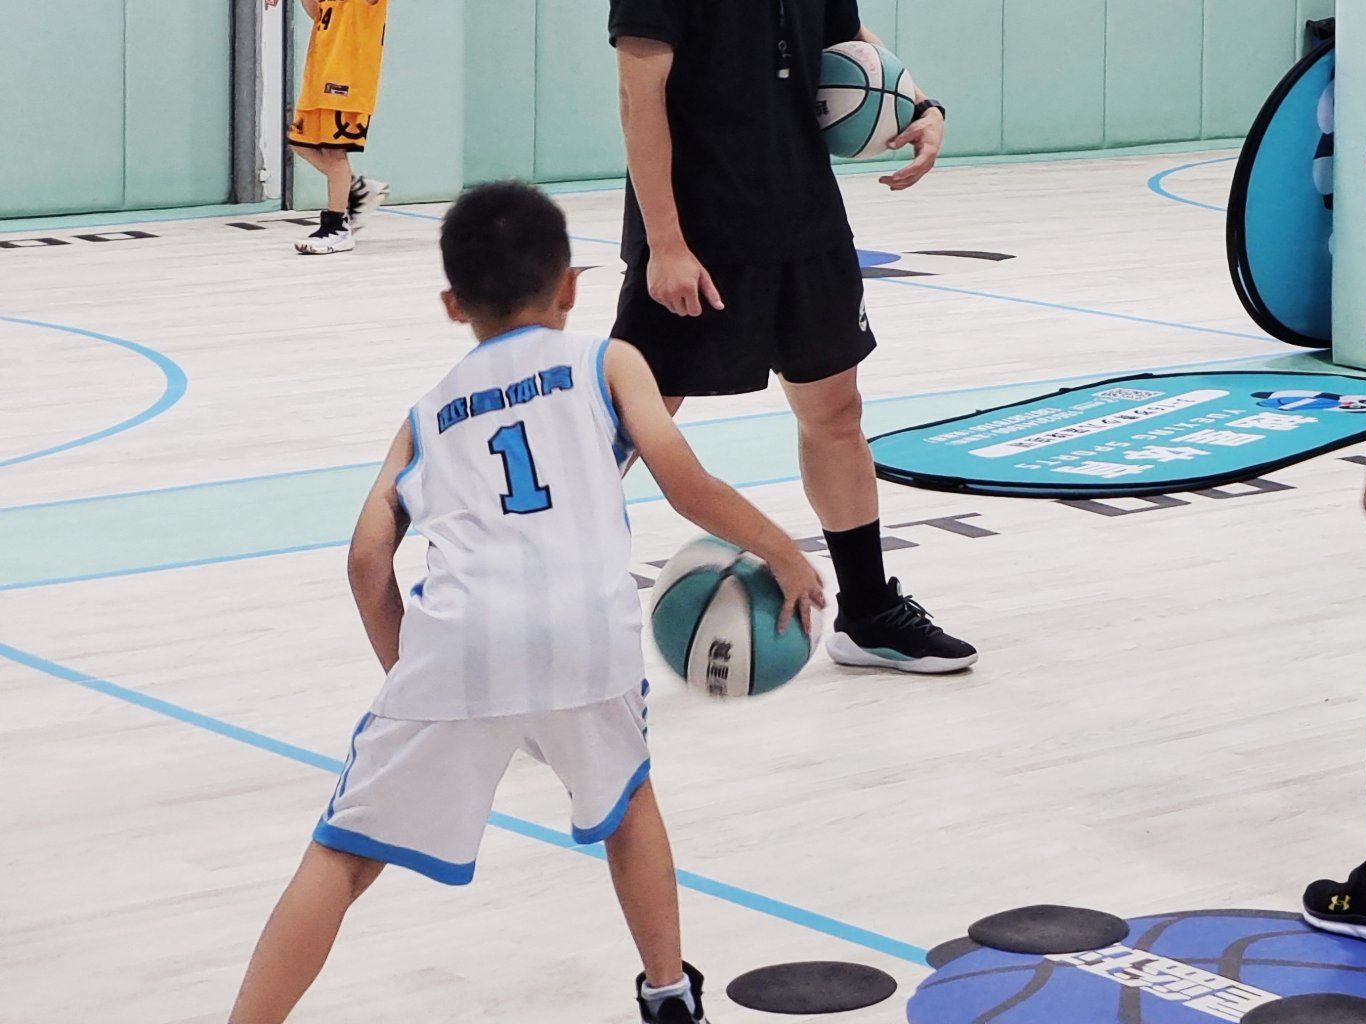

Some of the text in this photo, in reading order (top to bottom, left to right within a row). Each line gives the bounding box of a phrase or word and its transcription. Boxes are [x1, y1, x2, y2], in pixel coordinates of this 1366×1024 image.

[1050, 411, 1321, 479] 越星体育
[1130, 407, 1247, 441] YUEXING
[487, 419, 554, 516] 1
[1013, 440, 1131, 471] SPORTS
